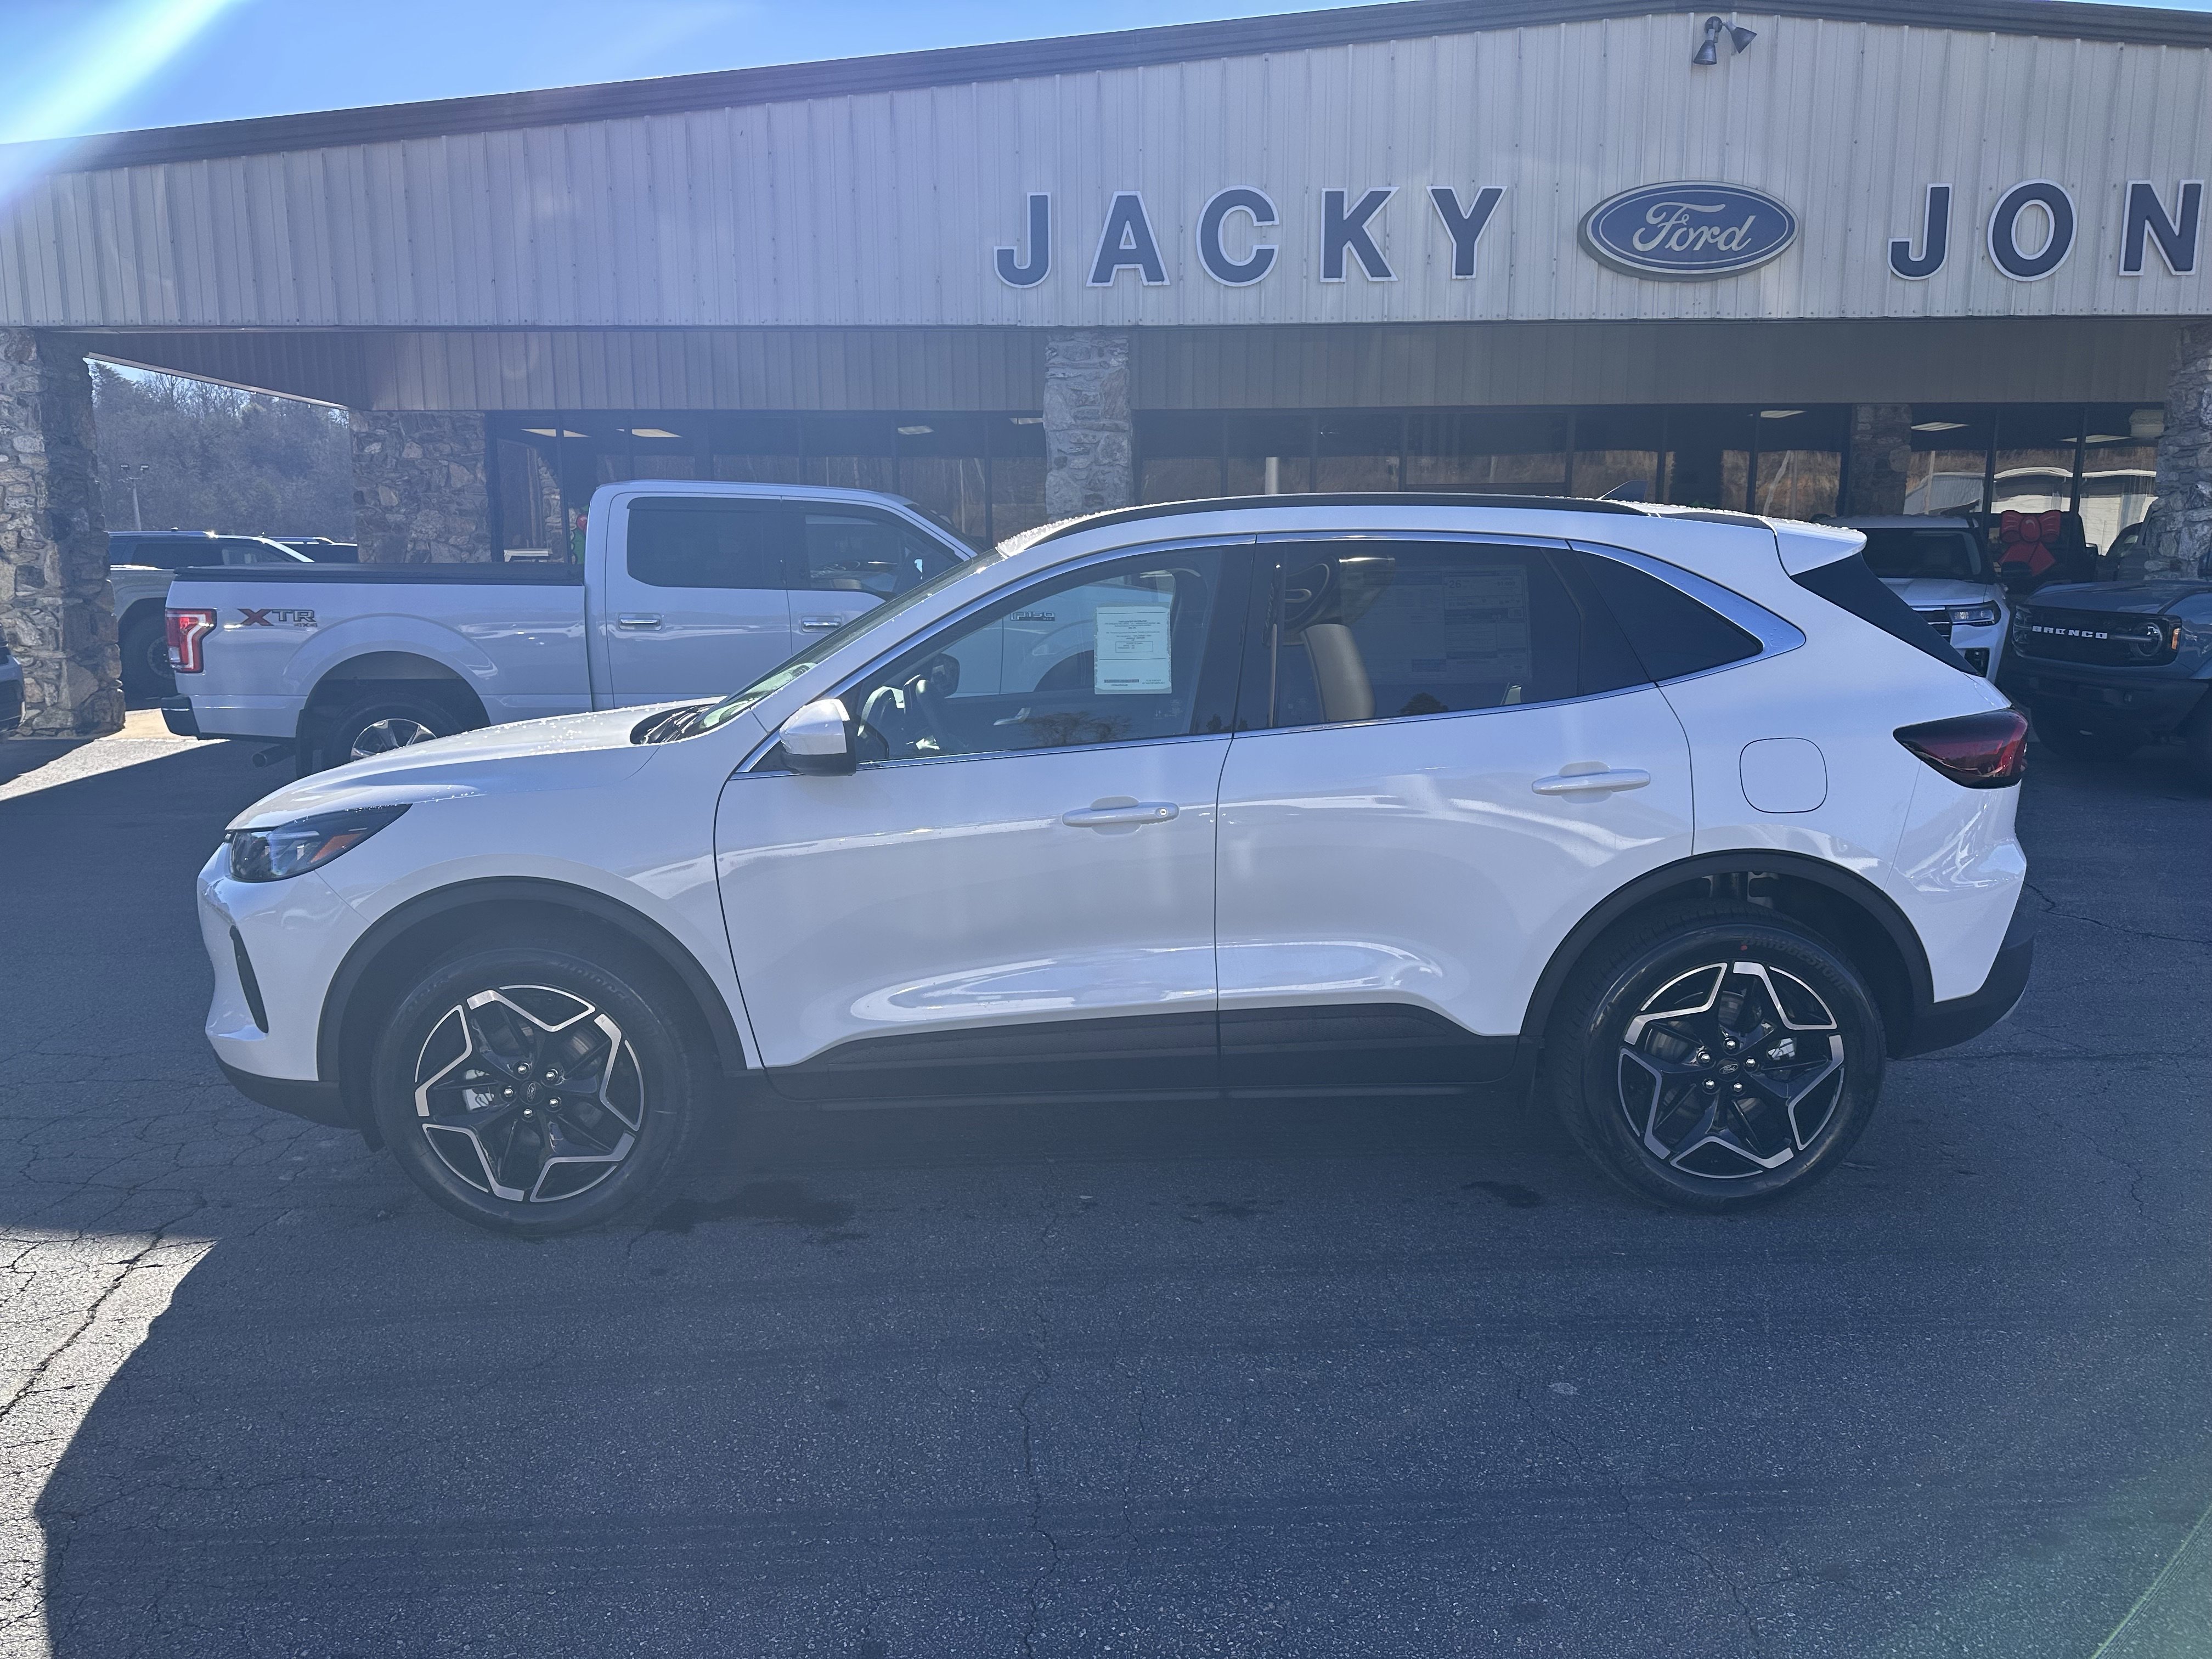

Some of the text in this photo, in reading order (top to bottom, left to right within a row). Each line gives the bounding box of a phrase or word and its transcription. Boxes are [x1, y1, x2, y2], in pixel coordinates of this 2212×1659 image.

[994, 185, 1508, 289] JACKY
[1632, 201, 1756, 252] Ford
[1887, 179, 2204, 281] JON
[237, 608, 316, 626] XTR
[2032, 625, 2108, 640] BRONCO
